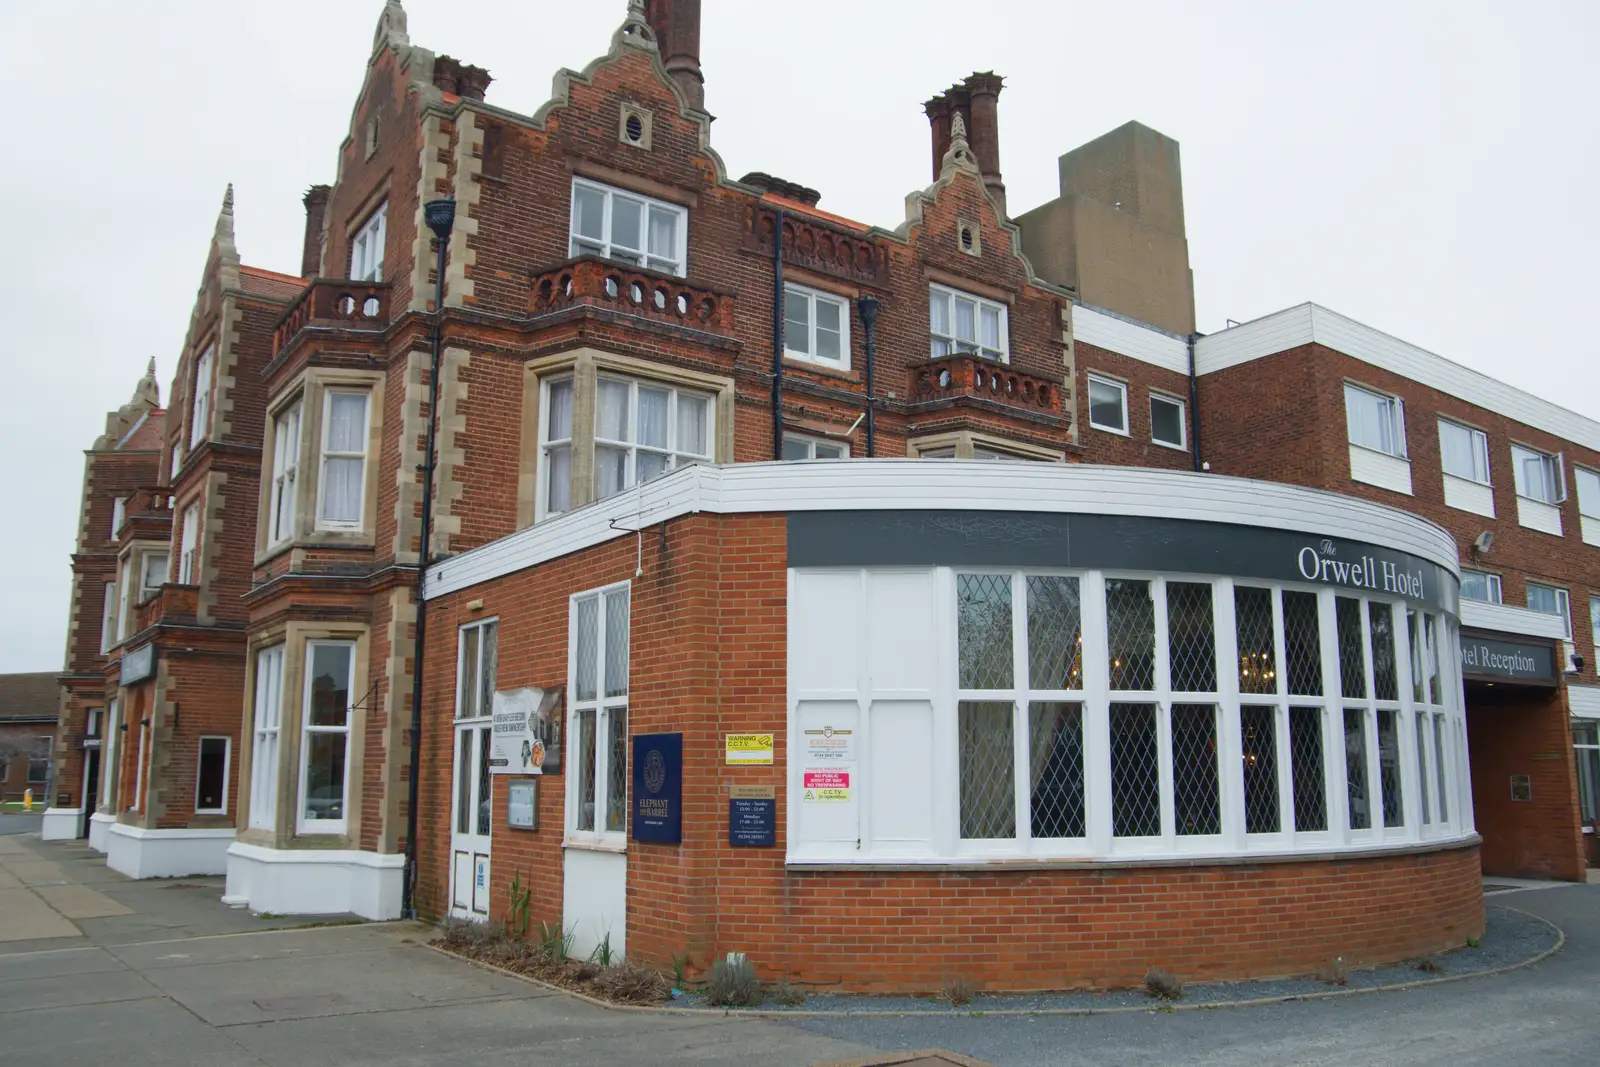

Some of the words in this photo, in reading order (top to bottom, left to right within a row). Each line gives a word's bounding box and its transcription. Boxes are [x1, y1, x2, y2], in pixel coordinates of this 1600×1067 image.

[1320, 539, 1336, 555] The
[1298, 547, 1377, 588] Orwell
[1381, 561, 1425, 599] Hotel
[1460, 645, 1479, 666] otel
[1481, 646, 1536, 675] Reception
[640, 799, 668, 808] ELEPHANT
[647, 808, 668, 817] BARREL
